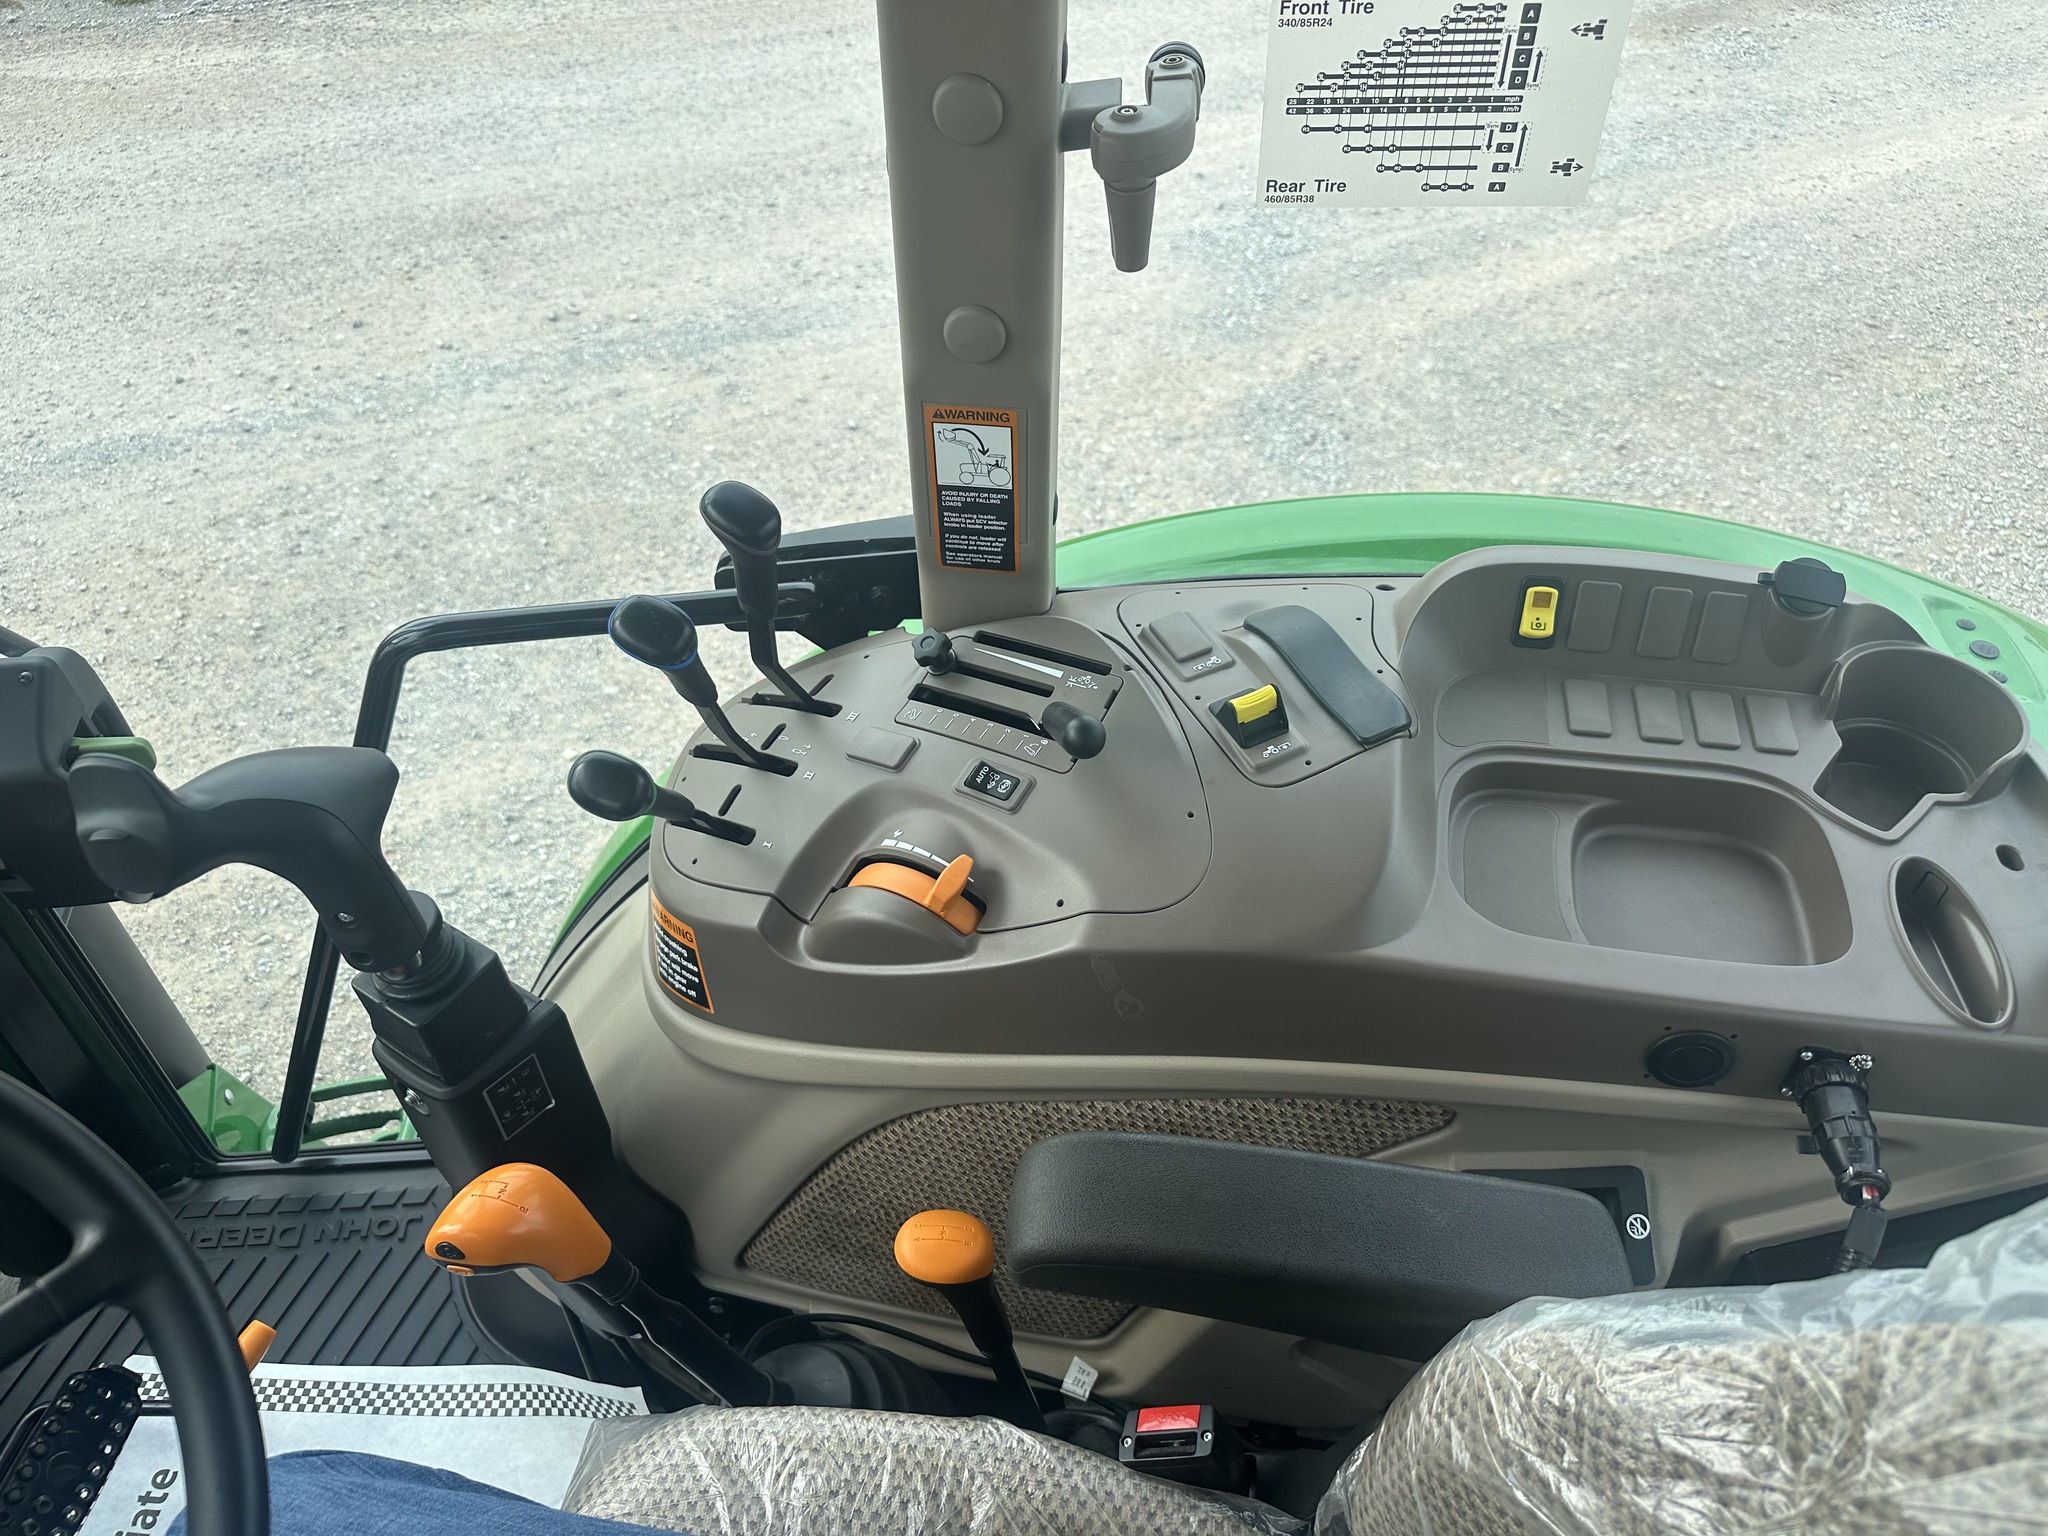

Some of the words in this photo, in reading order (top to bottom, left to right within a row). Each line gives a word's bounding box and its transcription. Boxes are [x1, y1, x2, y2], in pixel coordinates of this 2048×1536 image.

[1280, 0, 1329, 15] Front
[1339, 0, 1374, 14] Tire
[1278, 18, 1332, 27] 340/85R24
[1266, 180, 1305, 192] Rear
[1314, 179, 1346, 192] Tire
[1264, 195, 1314, 203] 460/85R38
[944, 409, 1010, 422] WARNING
[976, 766, 989, 783] AUTO
[314, 1213, 422, 1242] JOHN
[1149, 1412, 1186, 1422] PRESS
